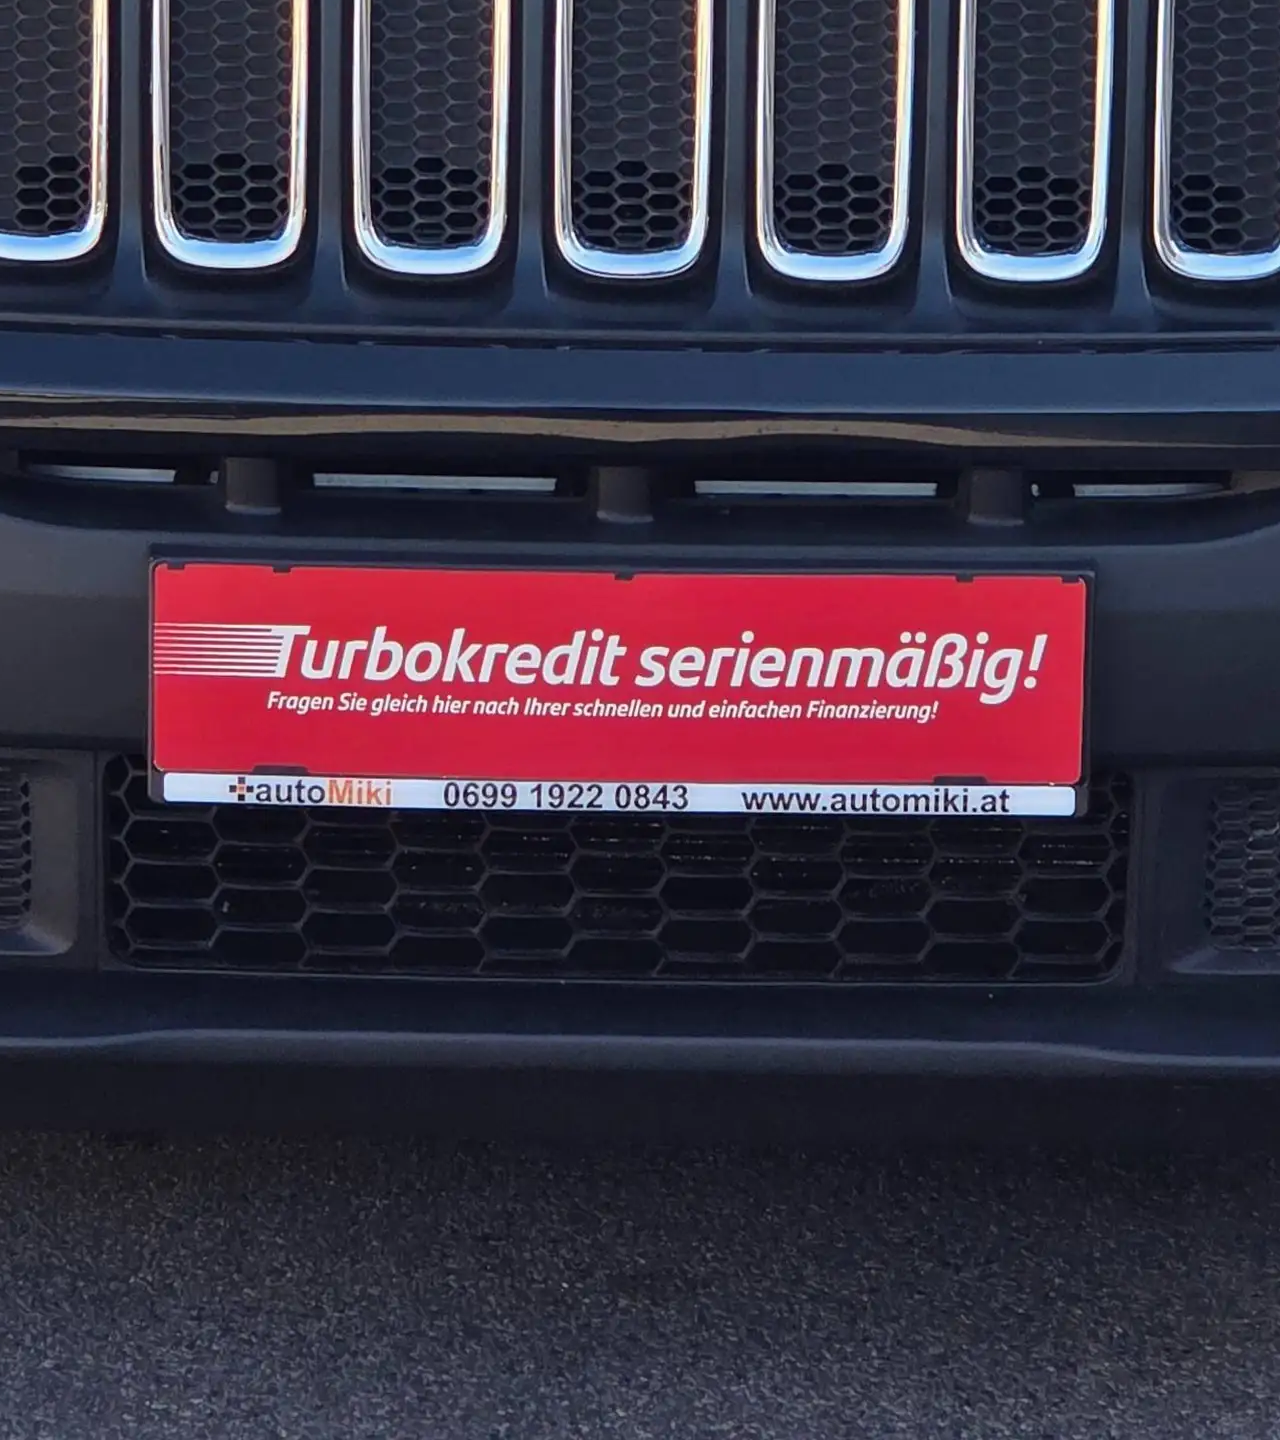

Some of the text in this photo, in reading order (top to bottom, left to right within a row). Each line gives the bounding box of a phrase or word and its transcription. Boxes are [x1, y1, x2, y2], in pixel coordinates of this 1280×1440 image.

[271, 624, 1048, 705] Turbokredit serienmäßig!
[267, 690, 940, 724] Fragen Sie gleich hier nach Ihrer schnellen und einfachen Finanzierung!
[255, 779, 1010, 813] autoMiki 0699 1922 0843 www.automiki.at
